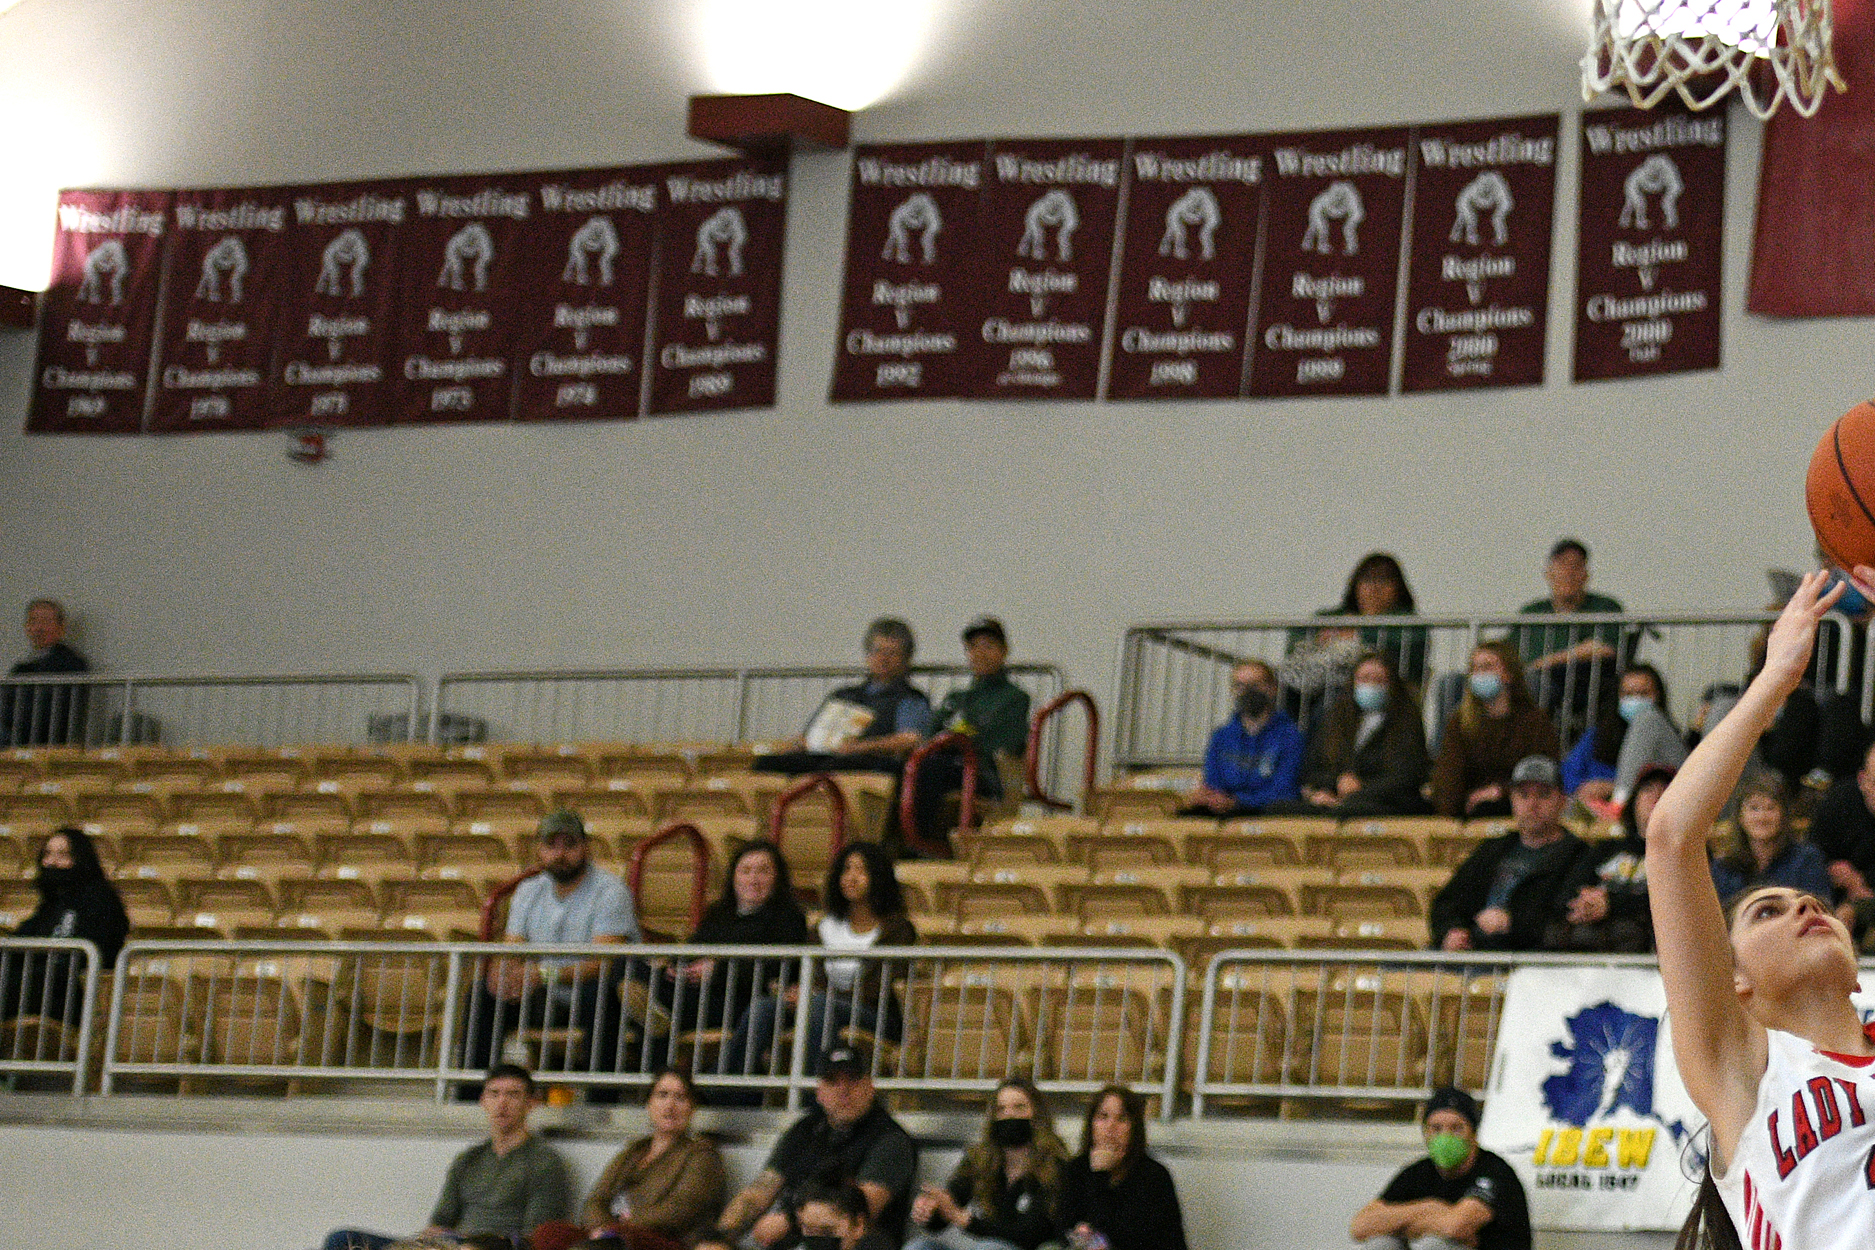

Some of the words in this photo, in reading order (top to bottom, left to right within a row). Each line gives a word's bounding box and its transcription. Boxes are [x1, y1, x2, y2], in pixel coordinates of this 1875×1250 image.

[1585, 115, 1722, 154] Wrestling
[1275, 145, 1407, 182] Wrestling
[1420, 133, 1553, 169] Wrestling
[858, 156, 981, 188] Wrestling
[995, 153, 1120, 188] Wrestling
[1134, 152, 1263, 184] Wrestling
[541, 183, 657, 213] Wrestling
[666, 174, 784, 202] Wrestling
[59, 203, 164, 236] Wrestling
[177, 203, 285, 232] Wrestling
[296, 196, 405, 226] Wrestling
[417, 191, 530, 220] Wrestling
[1441, 255, 1515, 282] Region
[1612, 241, 1688, 268] Region
[873, 280, 940, 305] Region
[1009, 268, 1078, 294] Region
[1148, 277, 1220, 302] Region
[1291, 273, 1364, 299] Region
[1416, 305, 1534, 335] Champions
[1586, 289, 1707, 322] Champions
[846, 328, 956, 357] Champions
[982, 318, 1092, 347] Champions
[1121, 327, 1234, 355] Champions
[1265, 324, 1379, 352] Champions
[1768, 1076, 1867, 1182] LADY
[1532, 1127, 1656, 1169] IBEW
